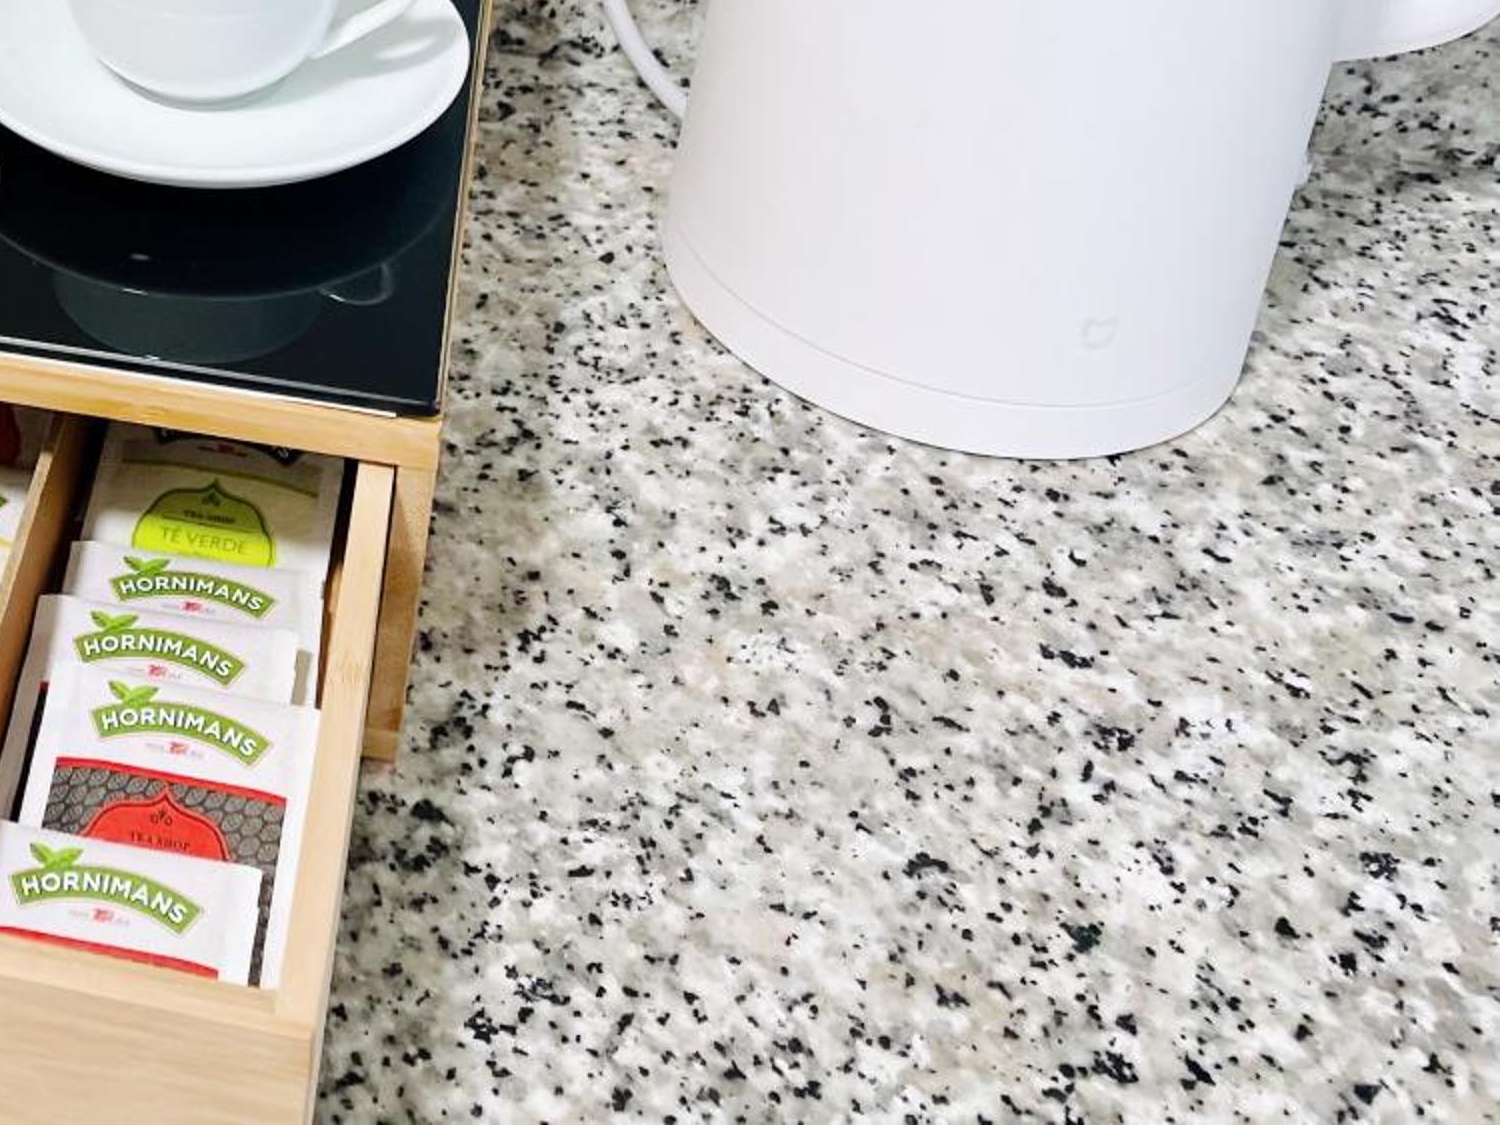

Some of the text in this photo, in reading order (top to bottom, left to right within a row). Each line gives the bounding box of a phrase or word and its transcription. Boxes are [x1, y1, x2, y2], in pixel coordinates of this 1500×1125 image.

[186, 530, 250, 555] VERDE
[119, 576, 263, 611] HORNIMANS
[84, 634, 232, 677] HORNIMANS
[101, 707, 257, 756] HORNIMANS
[21, 871, 187, 924] HORNIMANS
